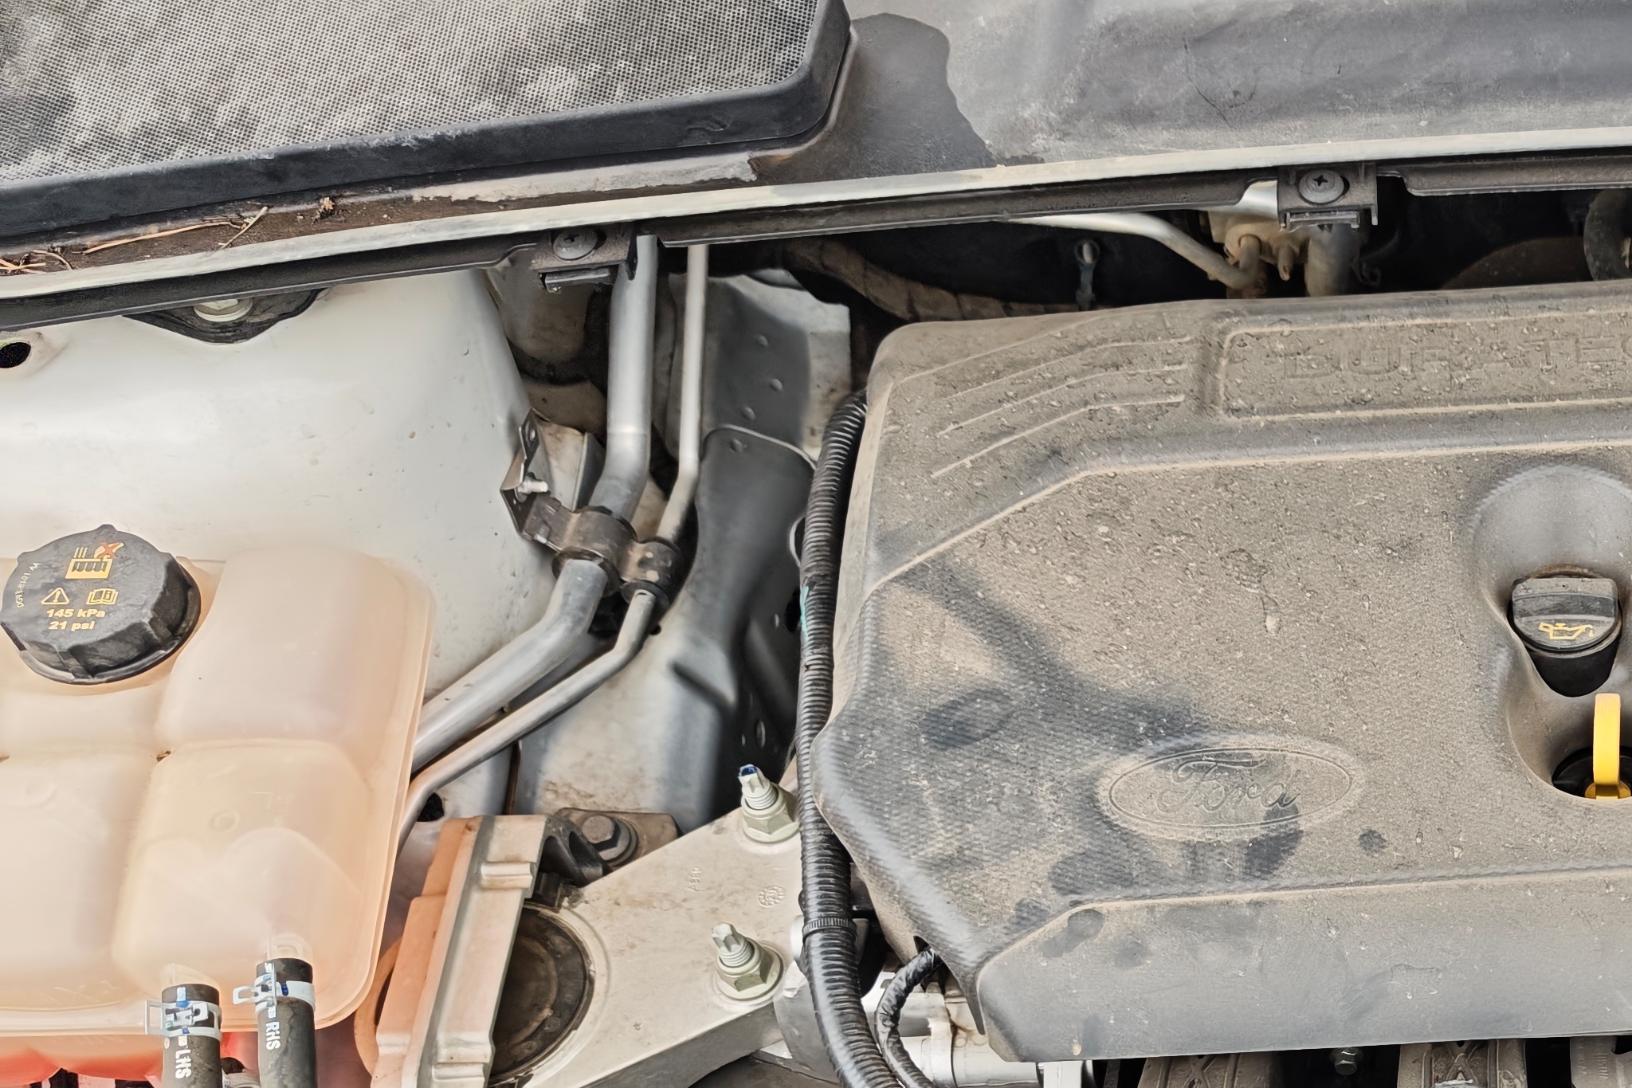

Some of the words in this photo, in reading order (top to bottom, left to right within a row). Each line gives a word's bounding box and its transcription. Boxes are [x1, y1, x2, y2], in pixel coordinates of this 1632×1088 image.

[46, 608, 75, 619] 145
[77, 608, 106, 618] kPa
[48, 621, 66, 631] 21
[71, 620, 96, 632] psi
[1156, 758, 1302, 813] Ford
[265, 1021, 282, 1051] RHS
[175, 1049, 192, 1080] LHS
